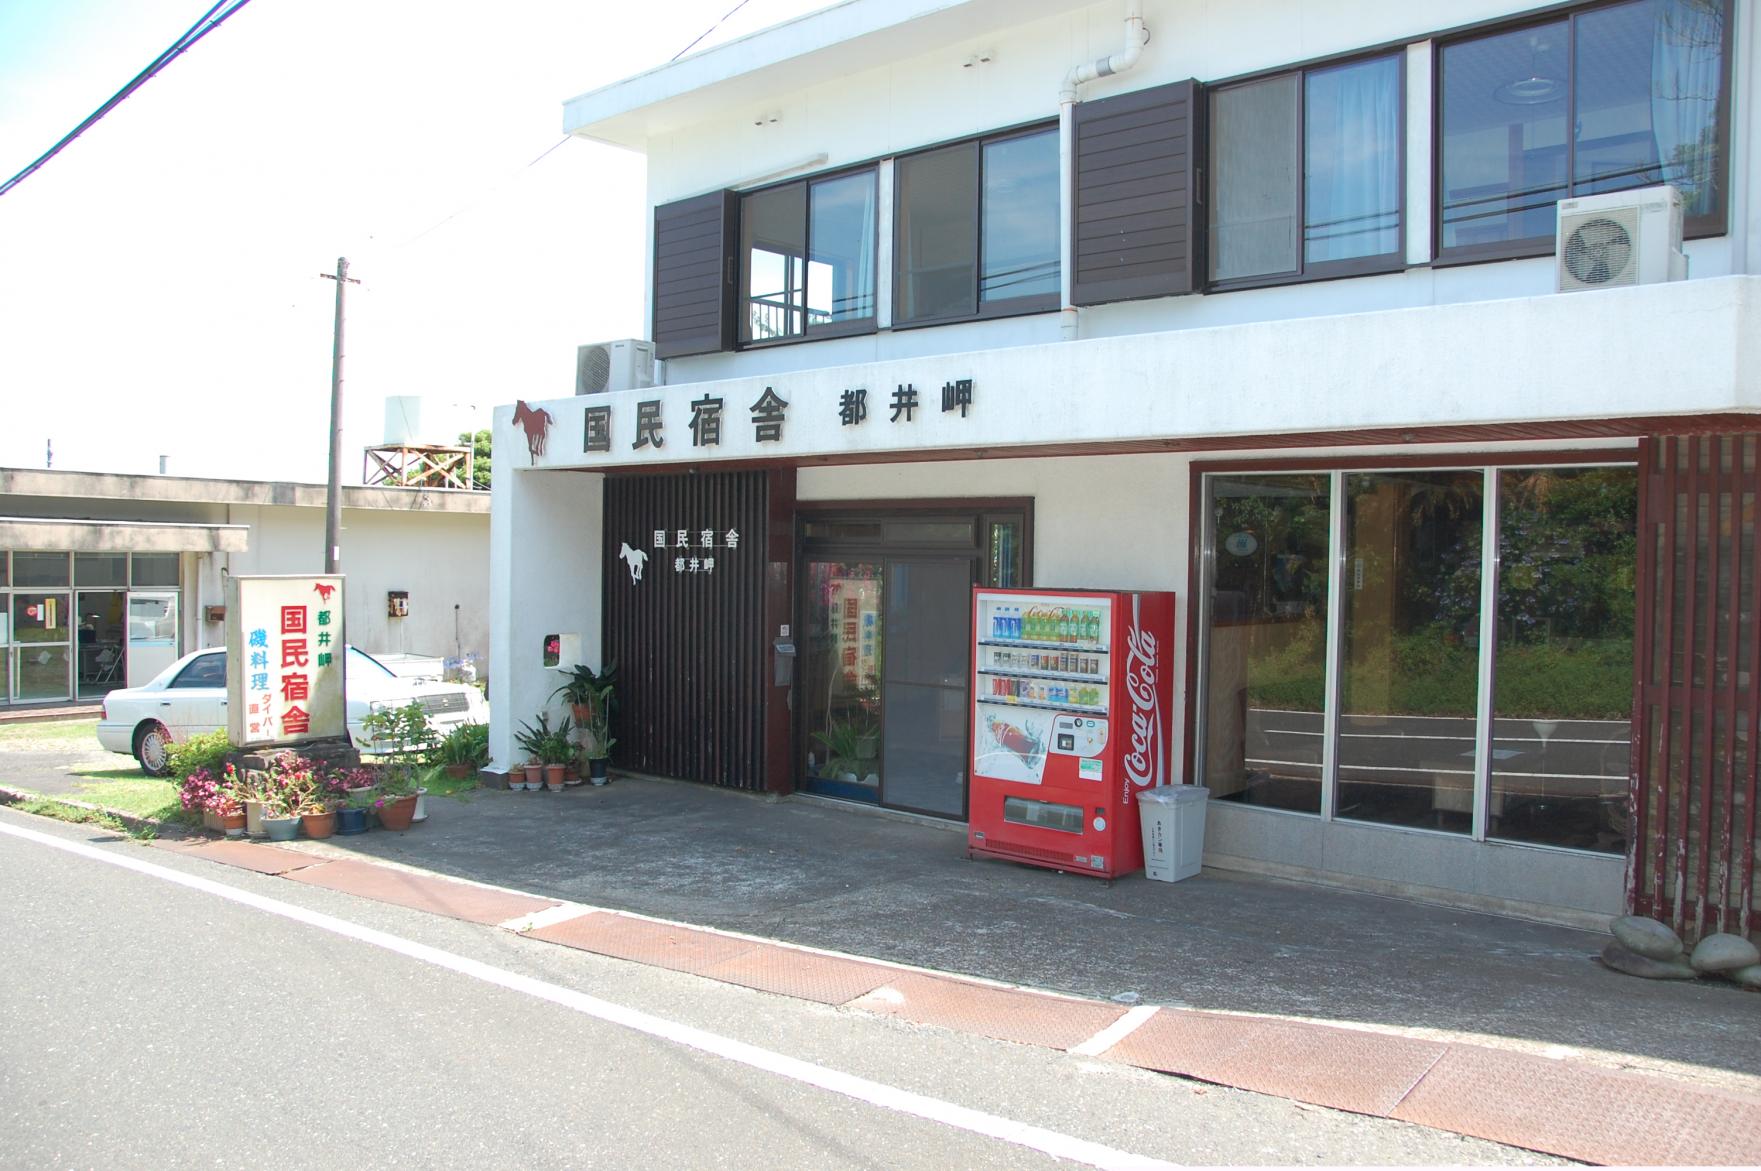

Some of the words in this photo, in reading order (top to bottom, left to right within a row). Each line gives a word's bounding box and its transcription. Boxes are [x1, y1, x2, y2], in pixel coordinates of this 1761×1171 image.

[583, 386, 789, 453] 国民宿舎
[838, 379, 973, 426] 都井岬
[653, 528, 740, 548] 国民宿舎
[674, 557, 715, 575] 都井岬
[249, 628, 270, 691] 磯料理
[317, 610, 332, 667] 都井岬
[280, 605, 310, 735] 国民宿舎
[1124, 625, 1157, 787] Coca-Cola
[1122, 778, 1130, 804] Enjoy
